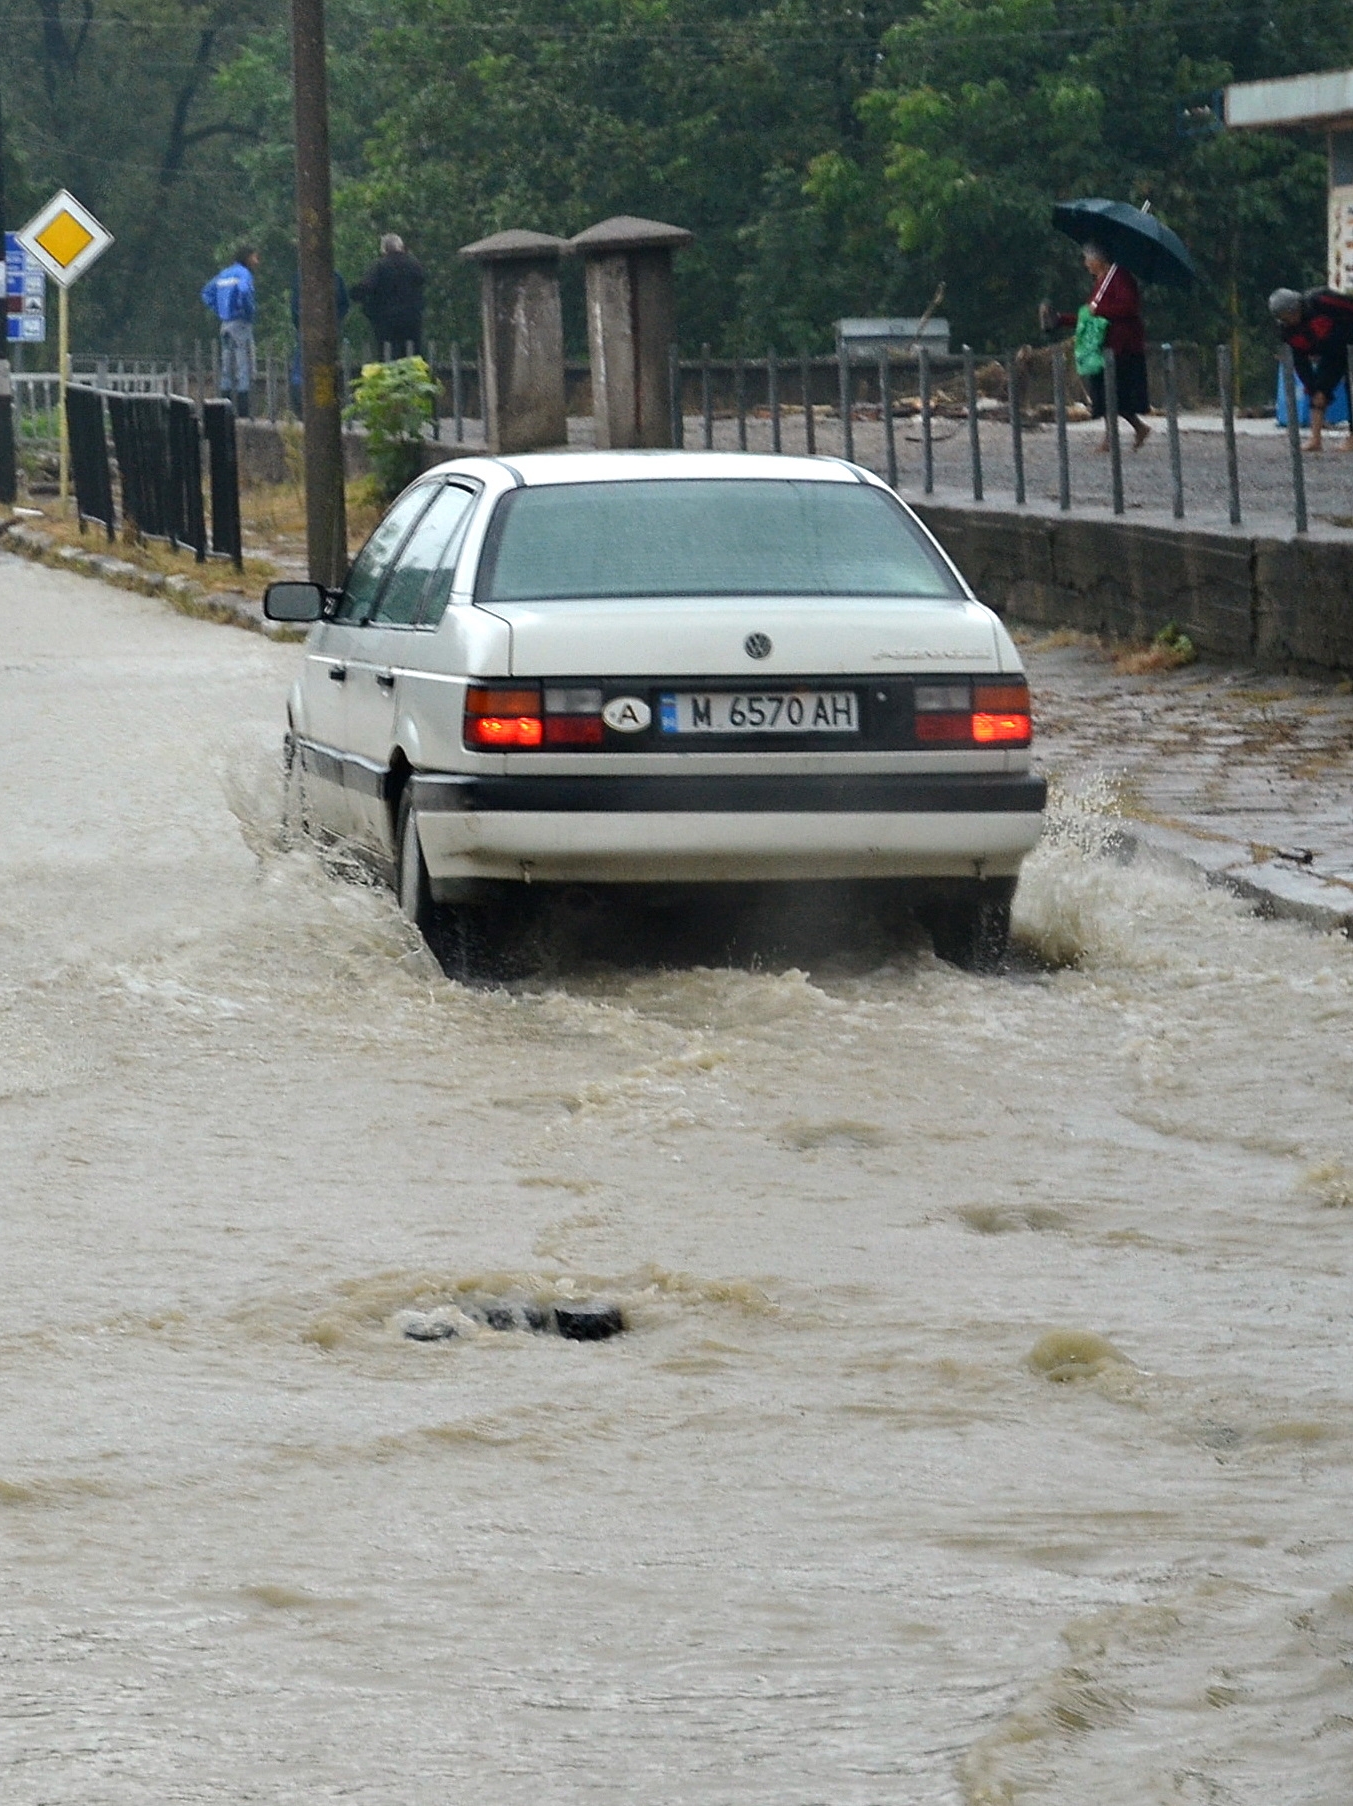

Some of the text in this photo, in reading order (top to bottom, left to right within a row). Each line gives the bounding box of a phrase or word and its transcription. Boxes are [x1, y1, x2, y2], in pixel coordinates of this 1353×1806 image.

[616, 702, 639, 725] A
[692, 695, 853, 727] M 6570 AH
